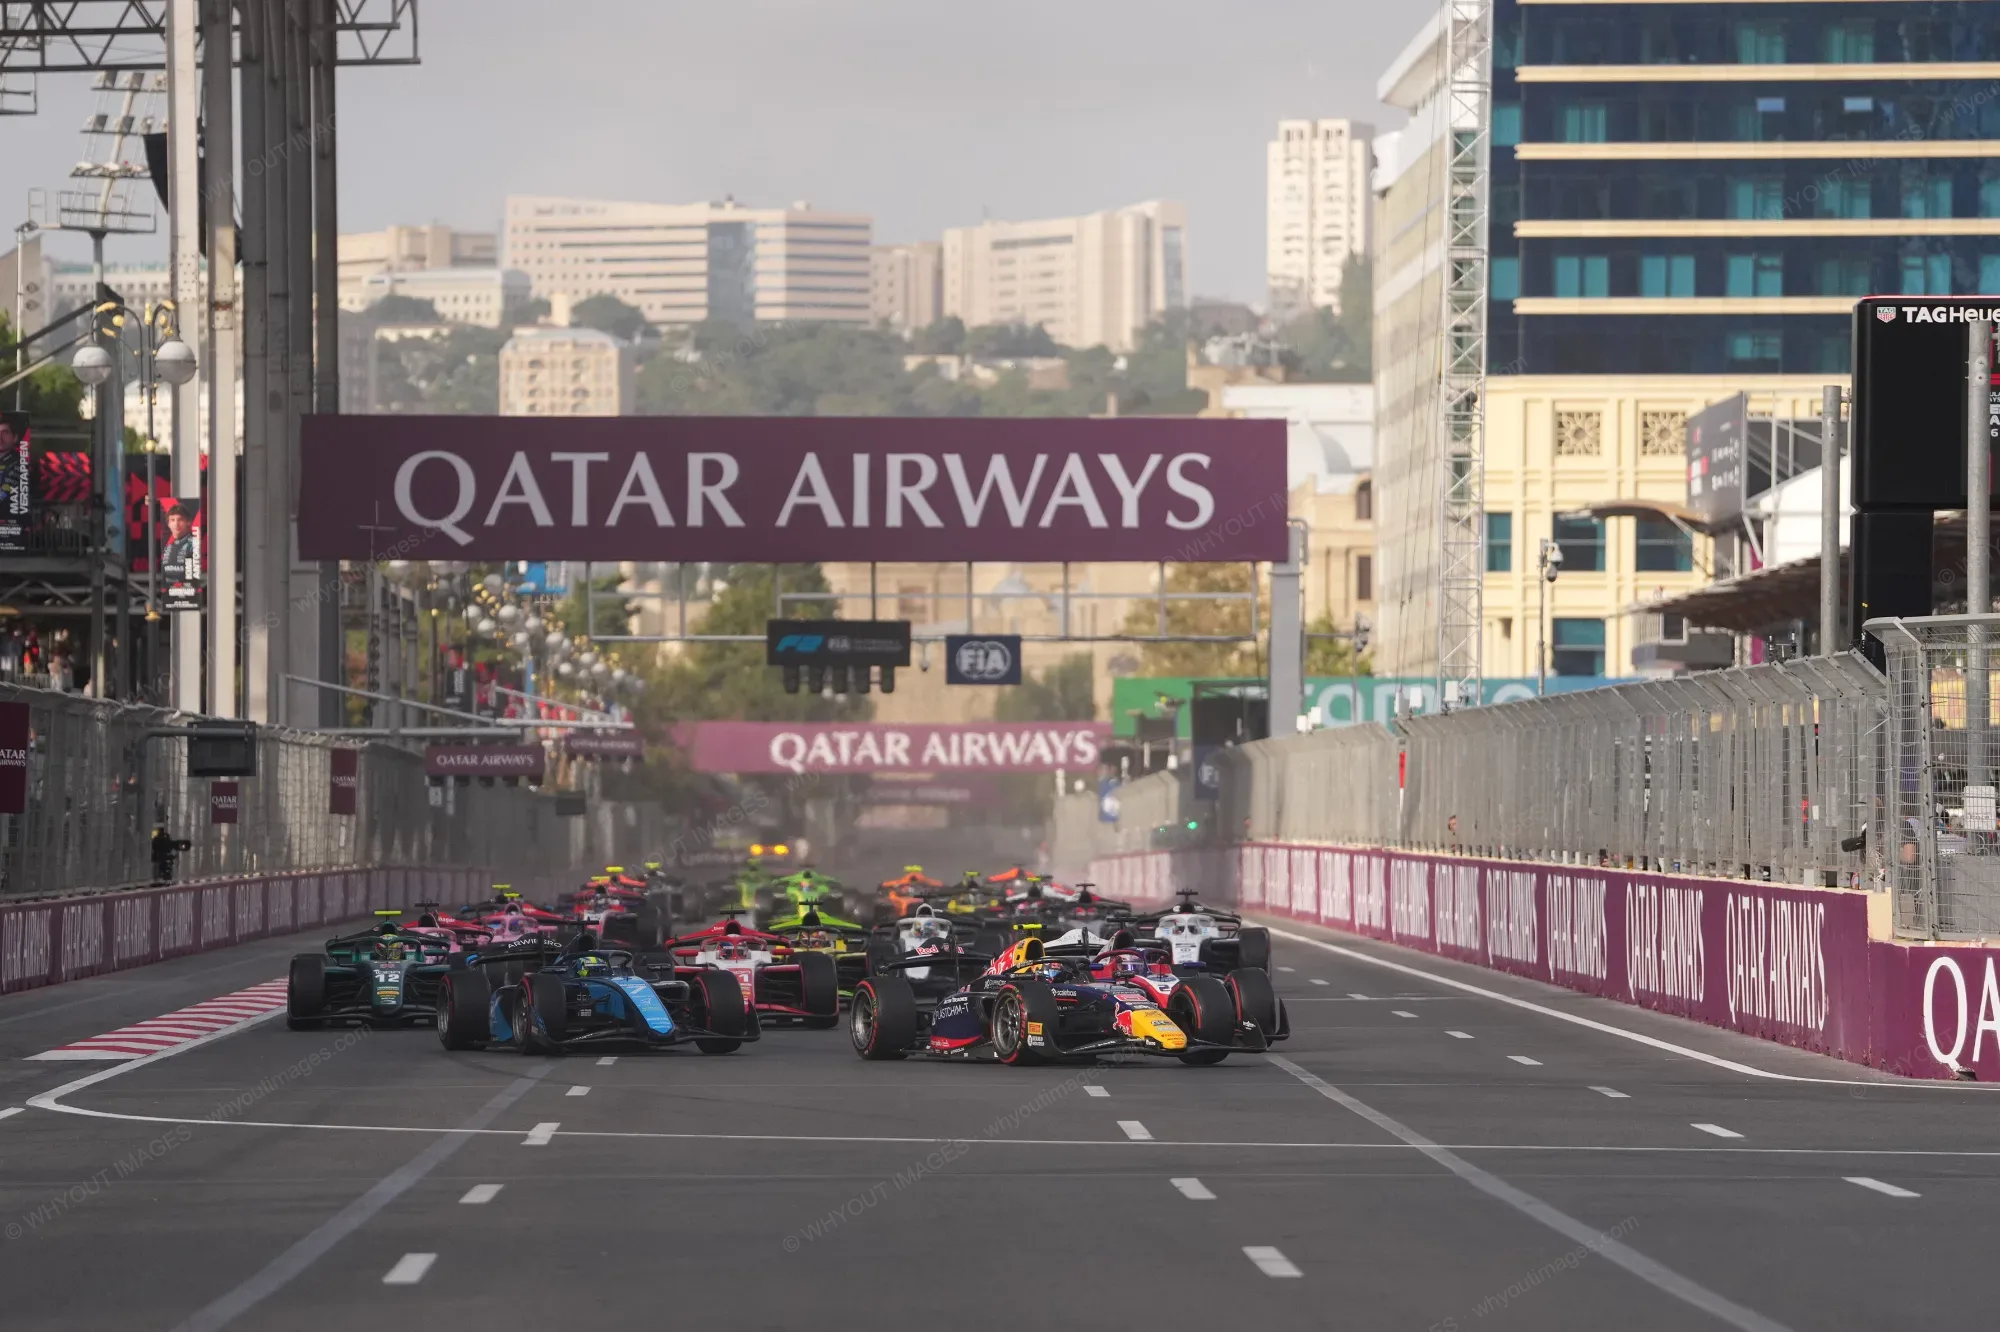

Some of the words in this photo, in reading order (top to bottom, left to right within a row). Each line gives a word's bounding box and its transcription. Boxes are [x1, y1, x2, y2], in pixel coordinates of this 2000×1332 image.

[20, 440, 28, 514] VERSTAPPEN
[10, 486, 18, 514] MAX
[394, 450, 750, 546] QATAR
[774, 451, 1217, 530] AIRWAYS
[0, 759, 25, 767] IRWAYS
[436, 754, 478, 768] QATAR
[481, 753, 534, 767] AIRWAYS
[770, 731, 912, 774] QATAR
[922, 730, 1097, 765] AIRWAYS
[212, 795, 237, 806] QATAR
[1626, 882, 1659, 999] QATAR
[1661, 885, 1704, 1002] AIRWAYS
[375, 974, 399, 983] 12
[1726, 893, 1767, 1024] QATAR
[1769, 898, 1825, 1031] AIRWAYS
